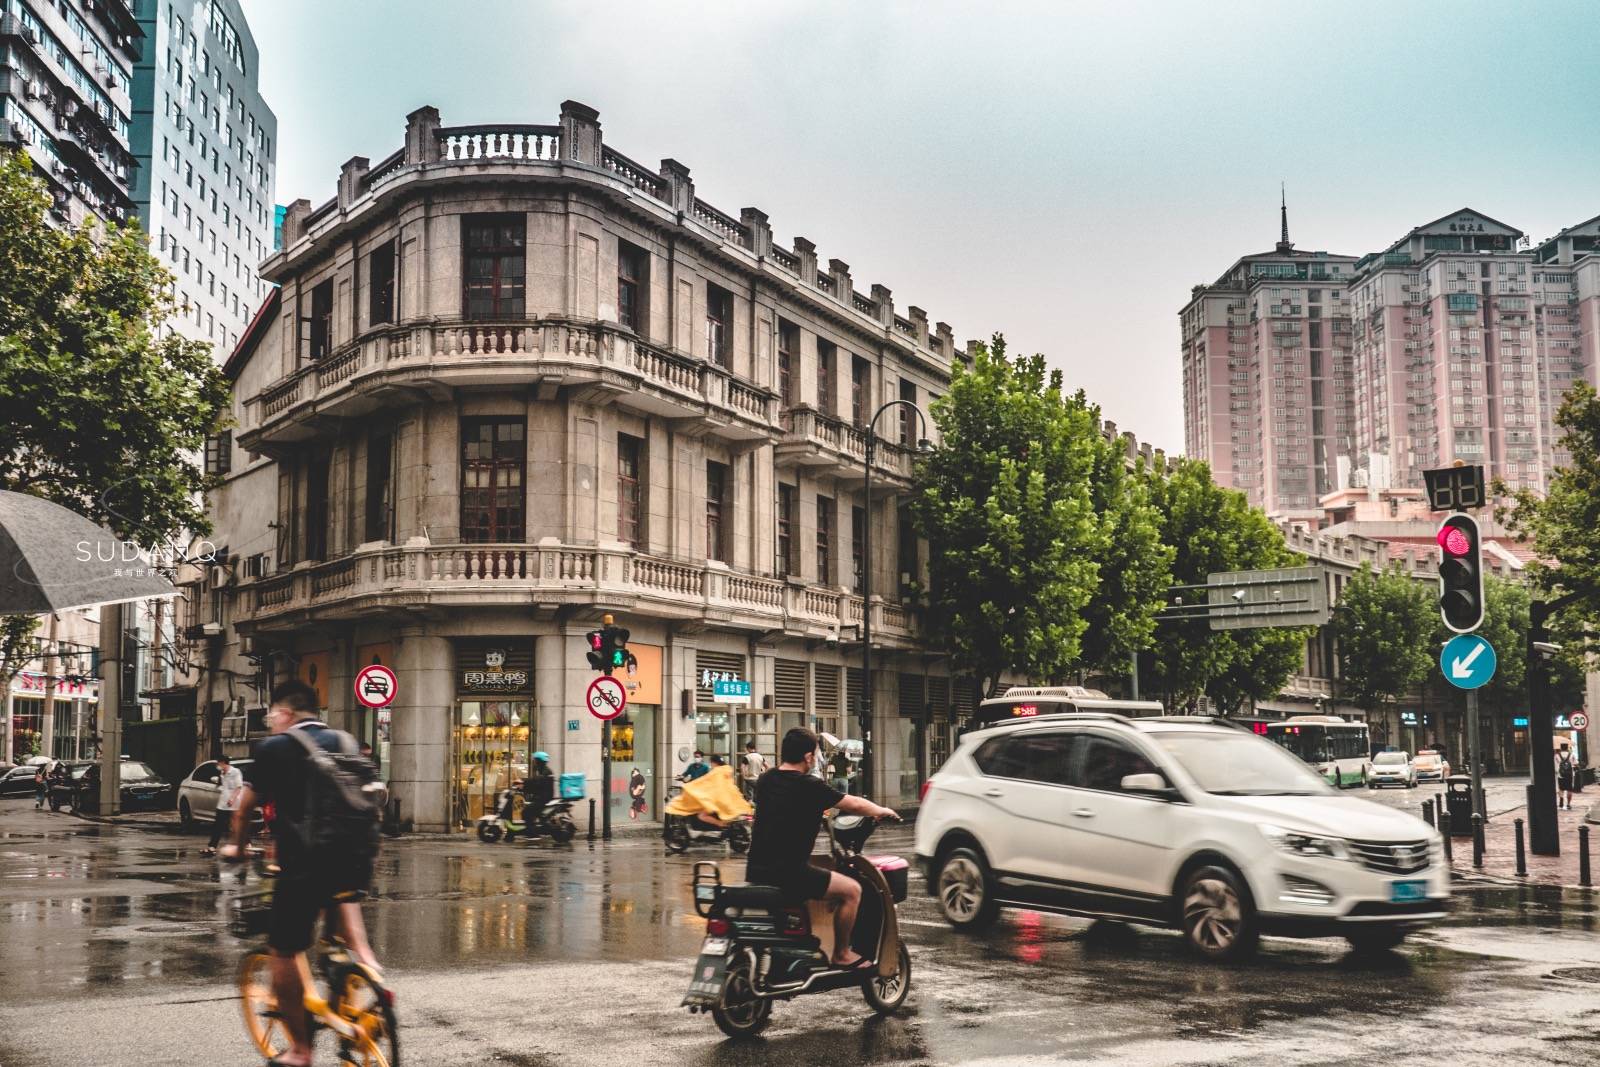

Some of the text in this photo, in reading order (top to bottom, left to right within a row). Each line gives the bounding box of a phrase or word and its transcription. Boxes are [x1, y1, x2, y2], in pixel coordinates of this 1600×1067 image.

[464, 672, 526, 685] 周黑鸭
[1574, 716, 1586, 726] 20
